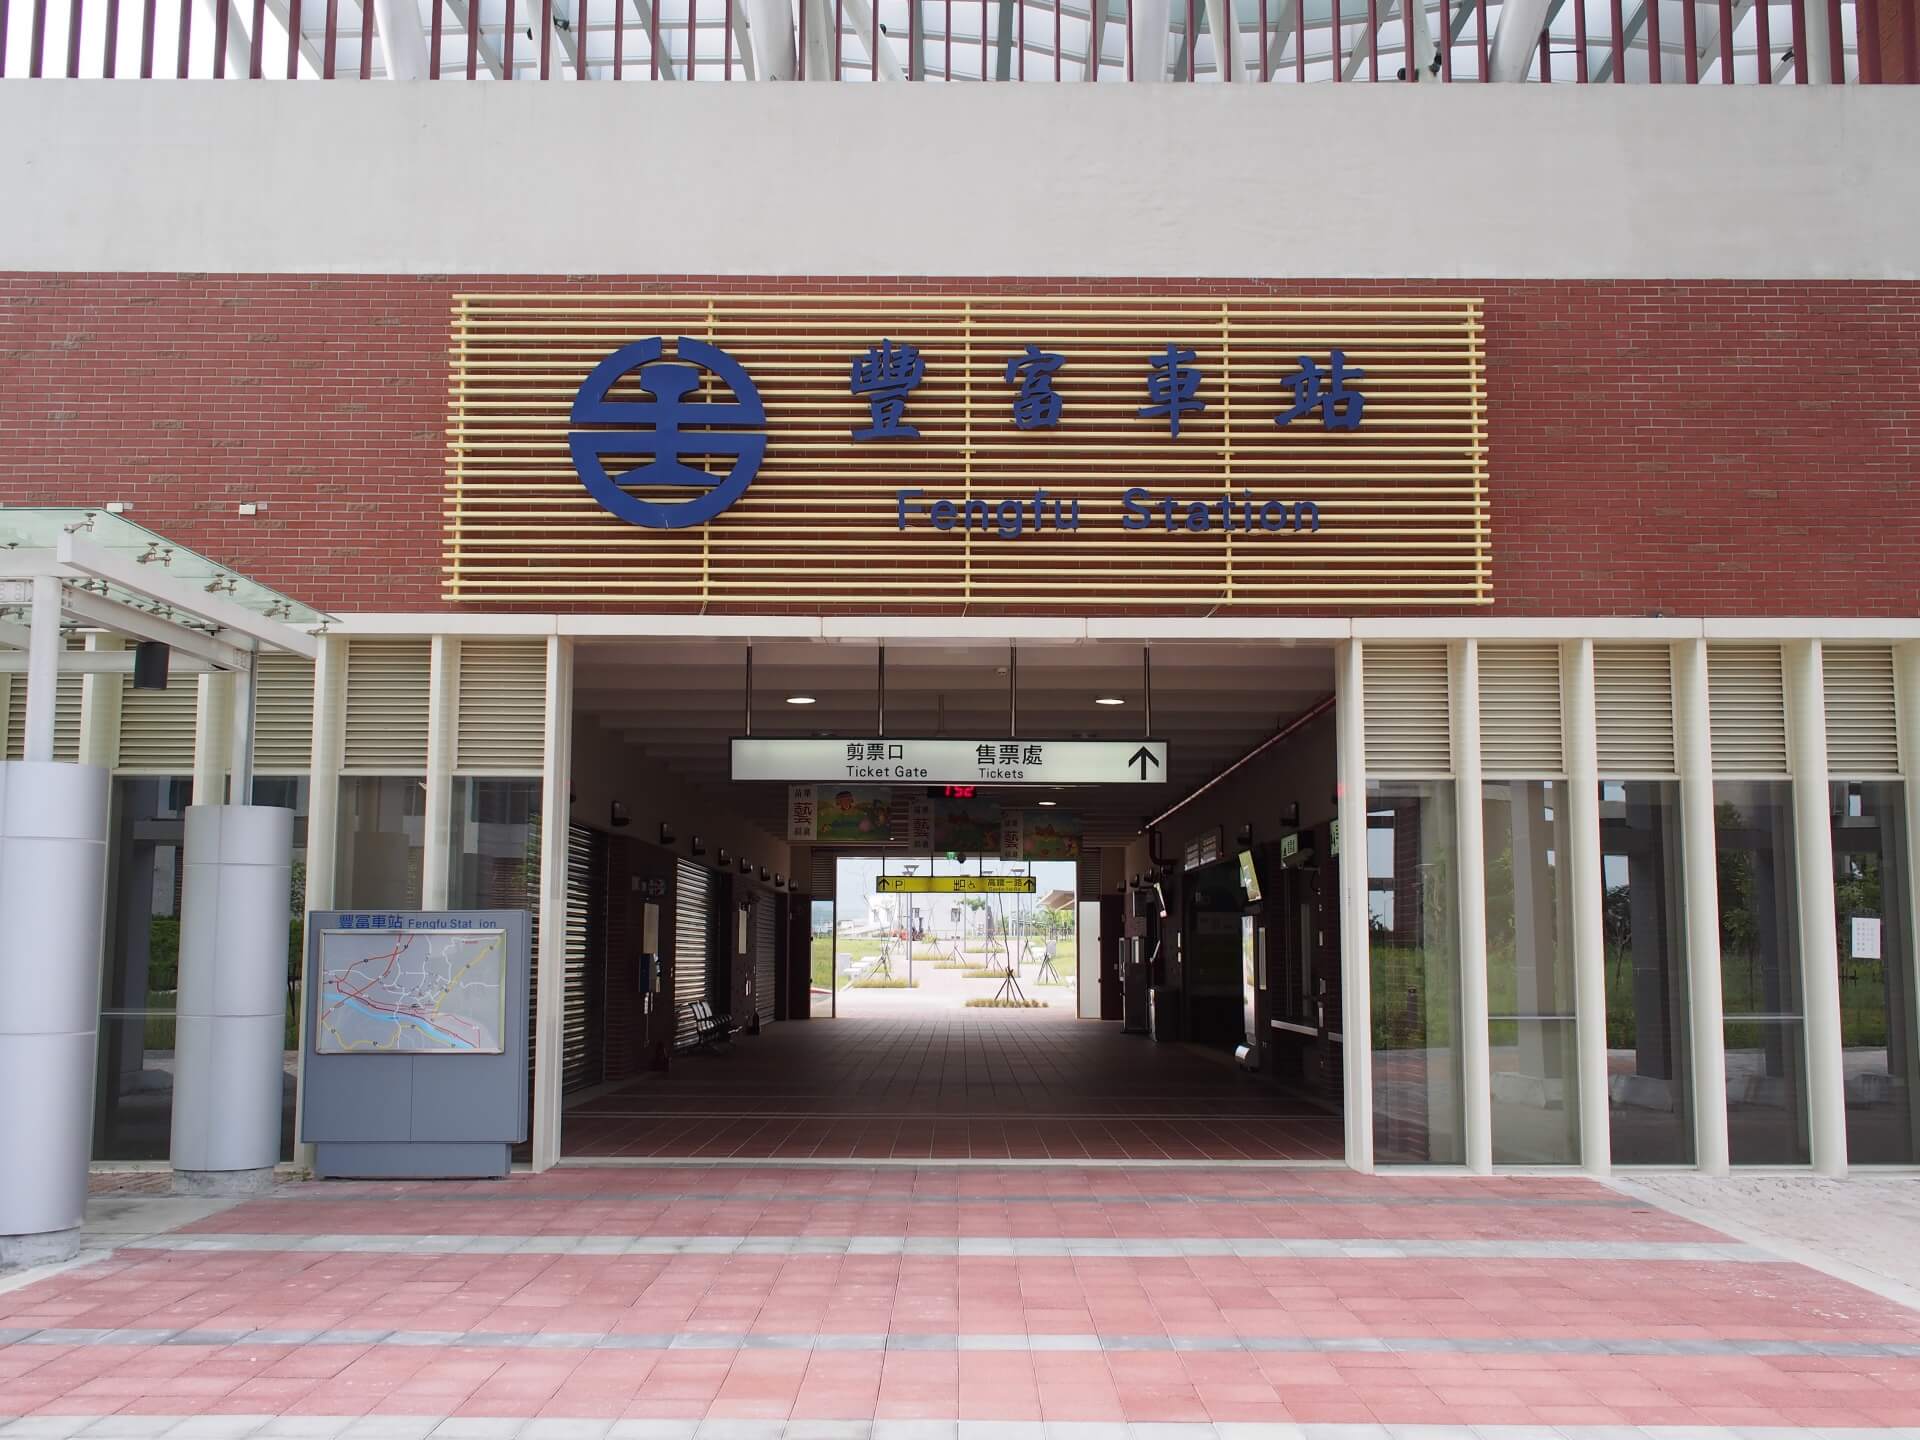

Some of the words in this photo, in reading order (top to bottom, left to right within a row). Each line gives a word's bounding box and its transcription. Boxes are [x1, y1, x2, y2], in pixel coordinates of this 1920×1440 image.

[850, 338, 1365, 441] 豐富車站
[897, 489, 1079, 538] Fengfu
[1122, 488, 1319, 532] Station
[846, 743, 904, 761] 剪票口
[976, 744, 1043, 766] 售票處
[846, 765, 890, 778] Ticket
[895, 765, 928, 778] Gate
[979, 767, 1024, 780] Tickets
[338, 914, 403, 929] 豐富車站
